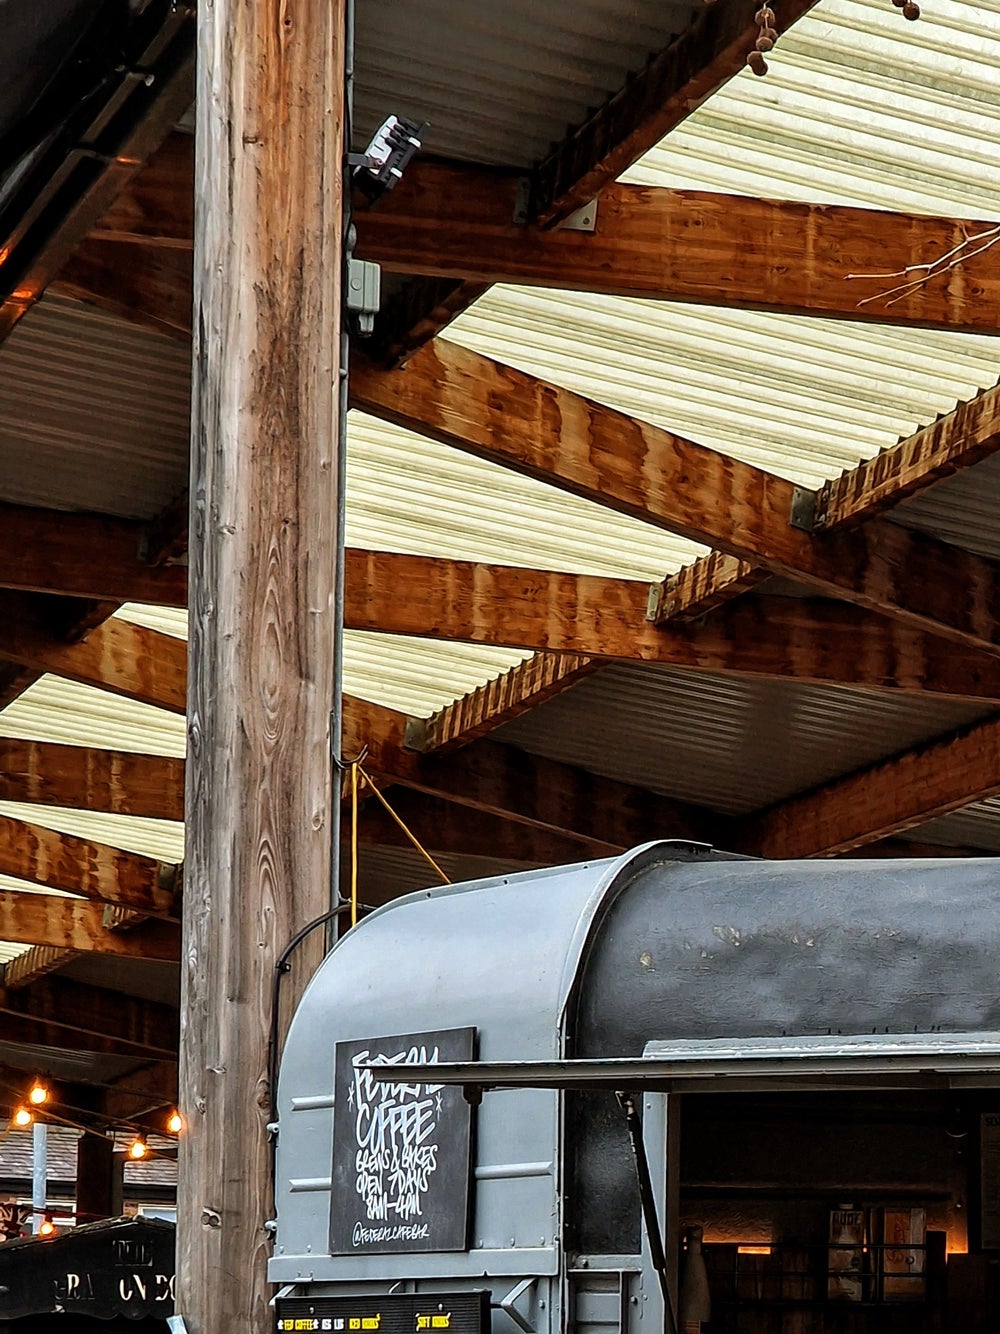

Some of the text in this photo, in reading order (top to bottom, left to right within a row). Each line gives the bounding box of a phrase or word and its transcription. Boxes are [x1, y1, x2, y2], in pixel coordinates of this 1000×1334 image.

[356, 1100, 436, 1153] COFFEE
[402, 1144, 439, 1171] BAKES
[356, 1173, 384, 1200] OPEN
